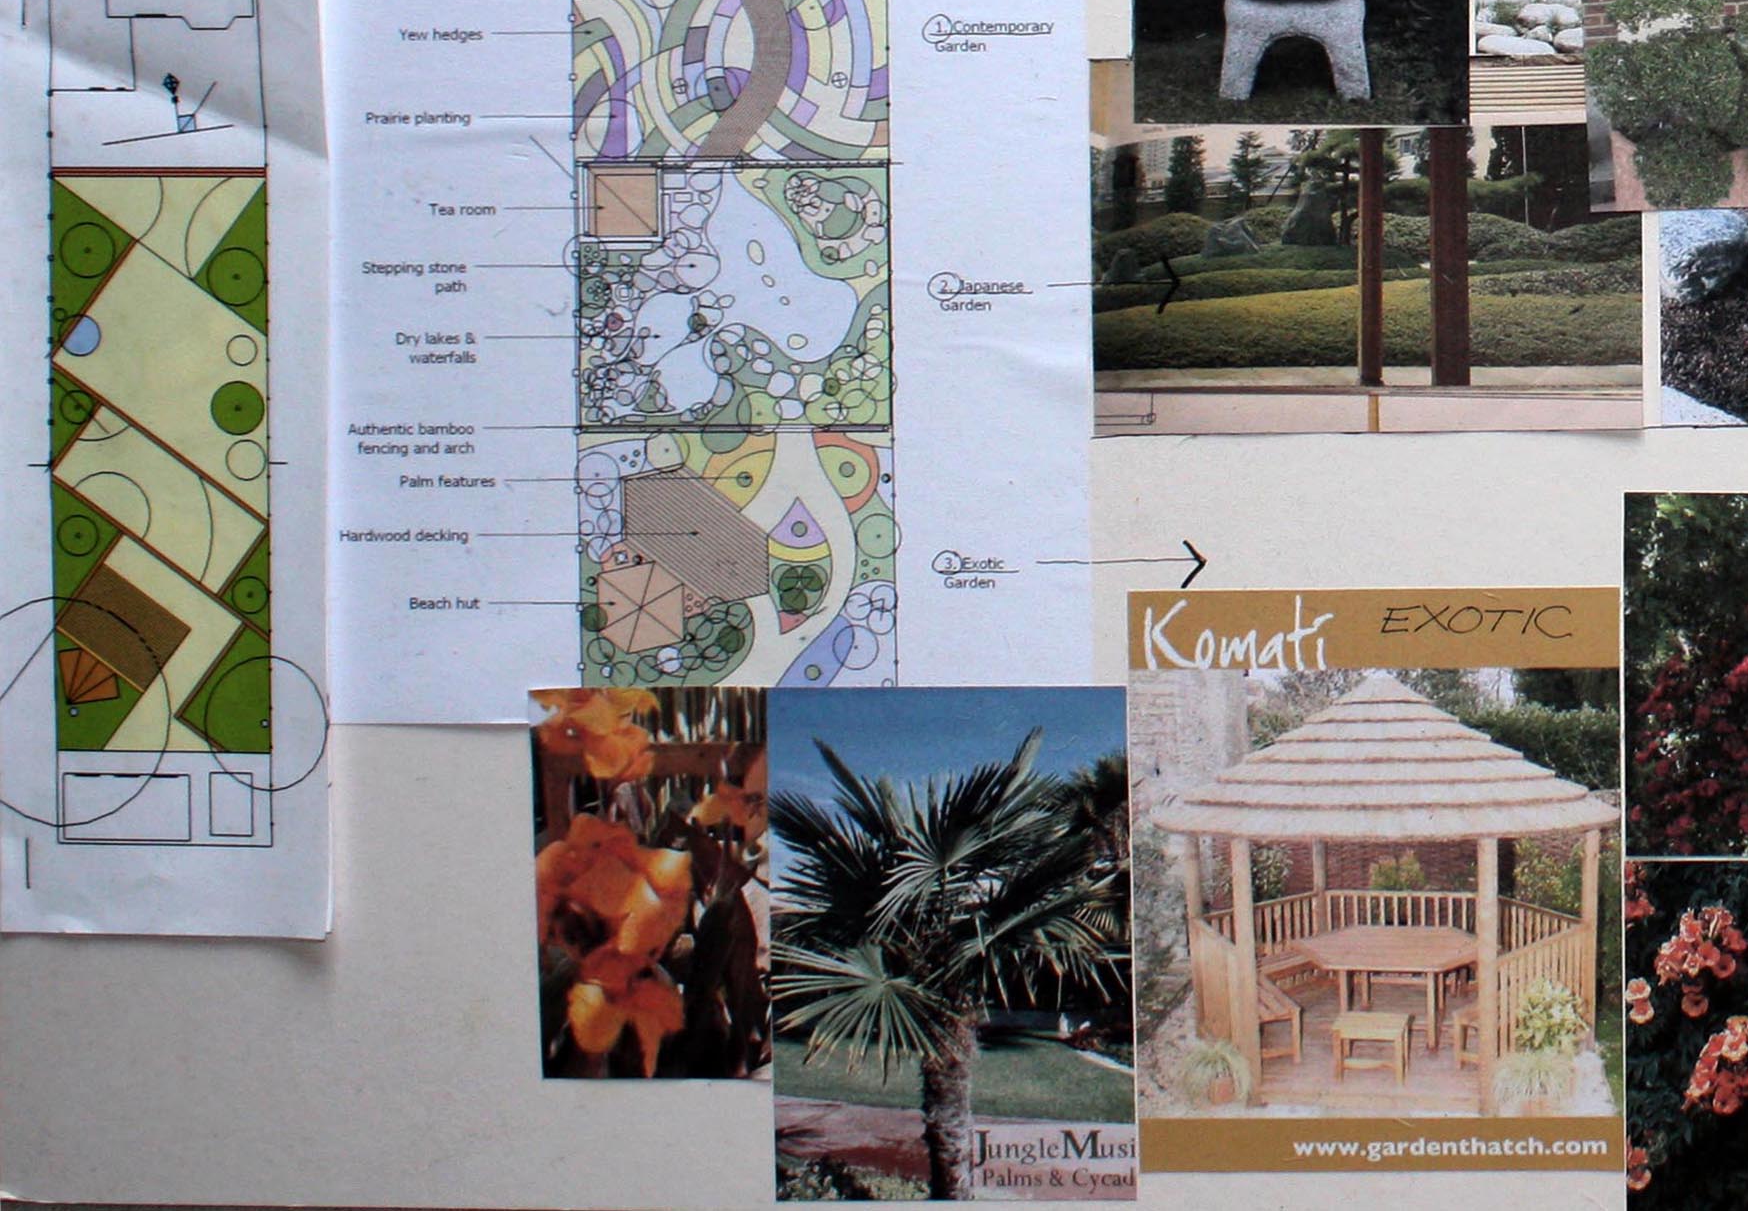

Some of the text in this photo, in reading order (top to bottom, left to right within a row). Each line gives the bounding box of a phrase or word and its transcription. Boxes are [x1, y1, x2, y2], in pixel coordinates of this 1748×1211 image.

[953, 19, 1054, 37] Contemporary
[399, 28, 484, 44] Yew hedges
[935, 39, 988, 53] Garden
[365, 111, 472, 126] Prairie planting
[429, 202, 497, 216] Tea room
[361, 261, 468, 277] Stepping stone
[435, 280, 468, 295] path
[960, 279, 1025, 295] Japanese
[939, 299, 992, 312] Garden
[395, 332, 477, 347] Dry lakes &
[409, 350, 477, 364] waterfalls
[347, 422, 475, 436] Authentic bamboo
[357, 441, 475, 457] fencing and arch
[399, 474, 497, 488] Palm features
[338, 528, 470, 545] Hardwood decking
[962, 556, 1005, 570] Exotic
[943, 576, 996, 590] Garden
[408, 596, 481, 610] Beach hut
[1379, 604, 1574, 639] EXOTIC
[1143, 593, 1334, 671] Komati
[1292, 1136, 1609, 1162] www.gardenthatch.com
[981, 1166, 1043, 1188] Palms
[1048, 1169, 1064, 1188] &
